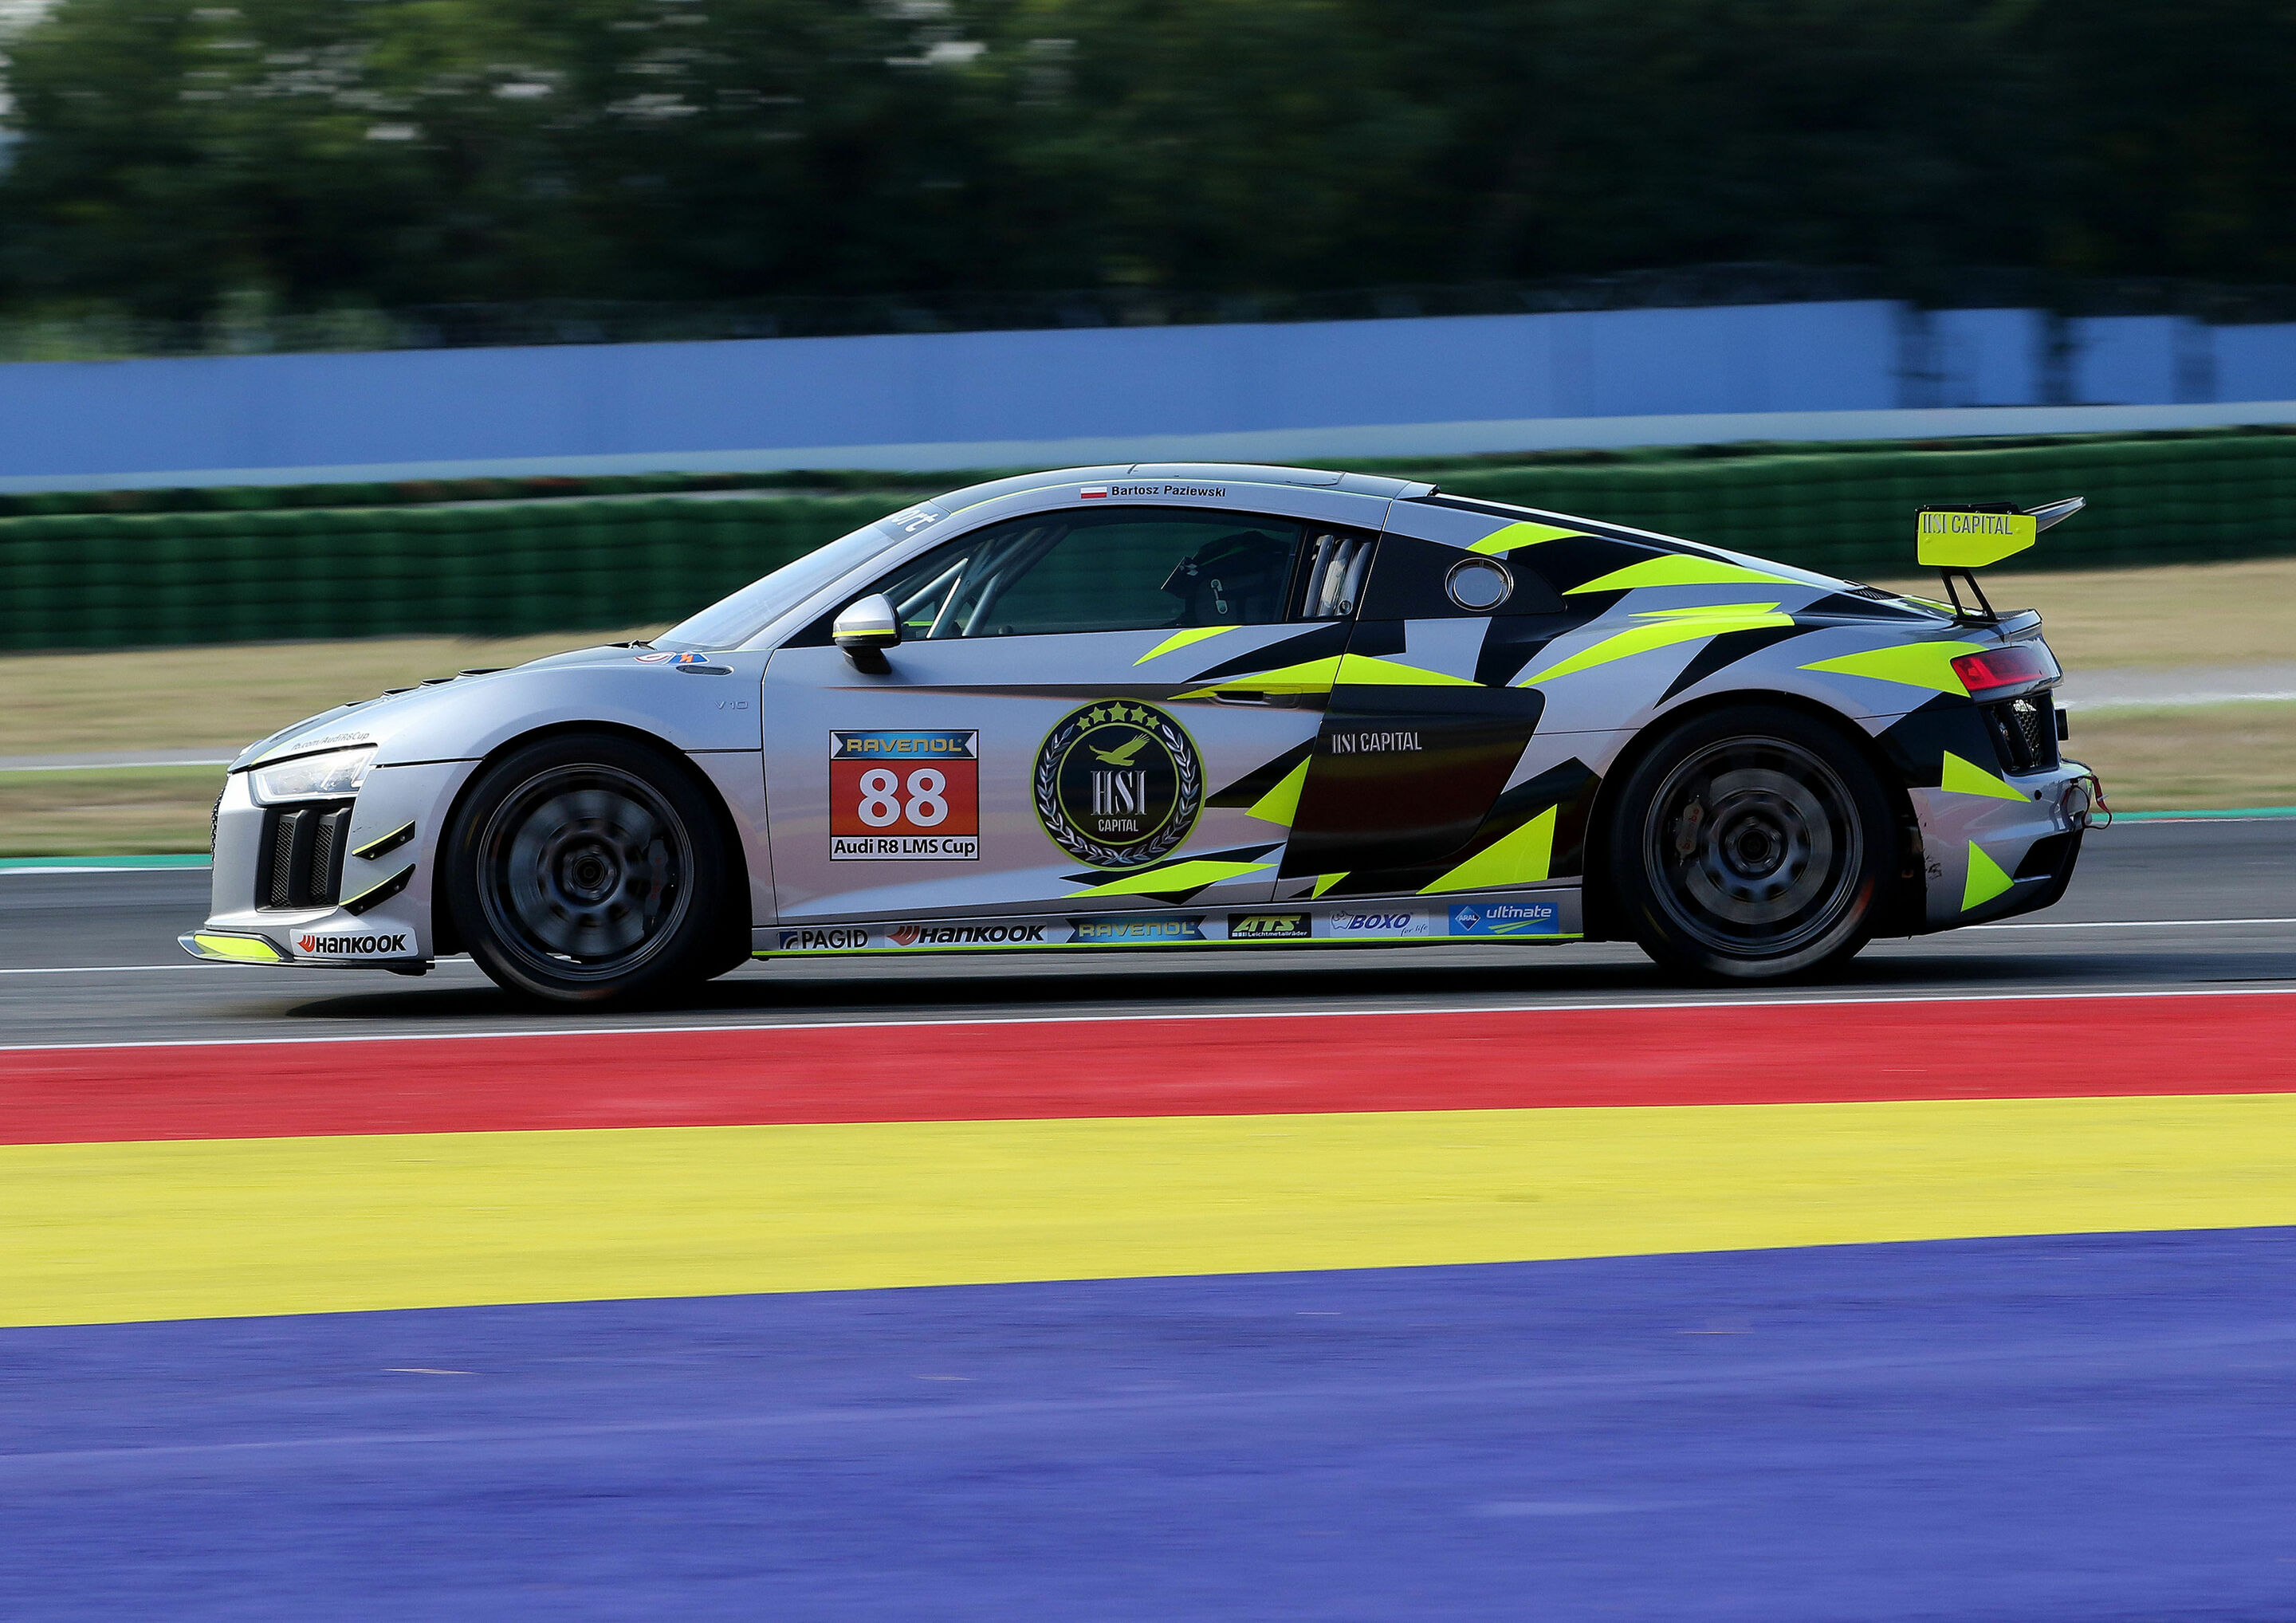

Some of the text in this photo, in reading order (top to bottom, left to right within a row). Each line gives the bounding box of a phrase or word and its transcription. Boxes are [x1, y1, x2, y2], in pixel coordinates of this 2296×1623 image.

[1111, 485, 1226, 497] Bartosz Paziewski
[1952, 514, 2014, 535] CAPITAL
[847, 738, 962, 753] RAVENOL
[1360, 732, 1423, 752] CAPITAL
[857, 768, 949, 828] 88
[1090, 770, 1147, 815] HSI
[1098, 819, 1139, 832] CAPITAL
[834, 839, 976, 857] Audi R8 LMS Cup
[1486, 905, 1552, 918] ultimate
[1078, 922, 1196, 937] RAVENOL
[1233, 915, 1301, 932] ATS
[1348, 914, 1411, 930] BOXO
[1400, 924, 1429, 937] for life
[801, 929, 868, 949] PAGID
